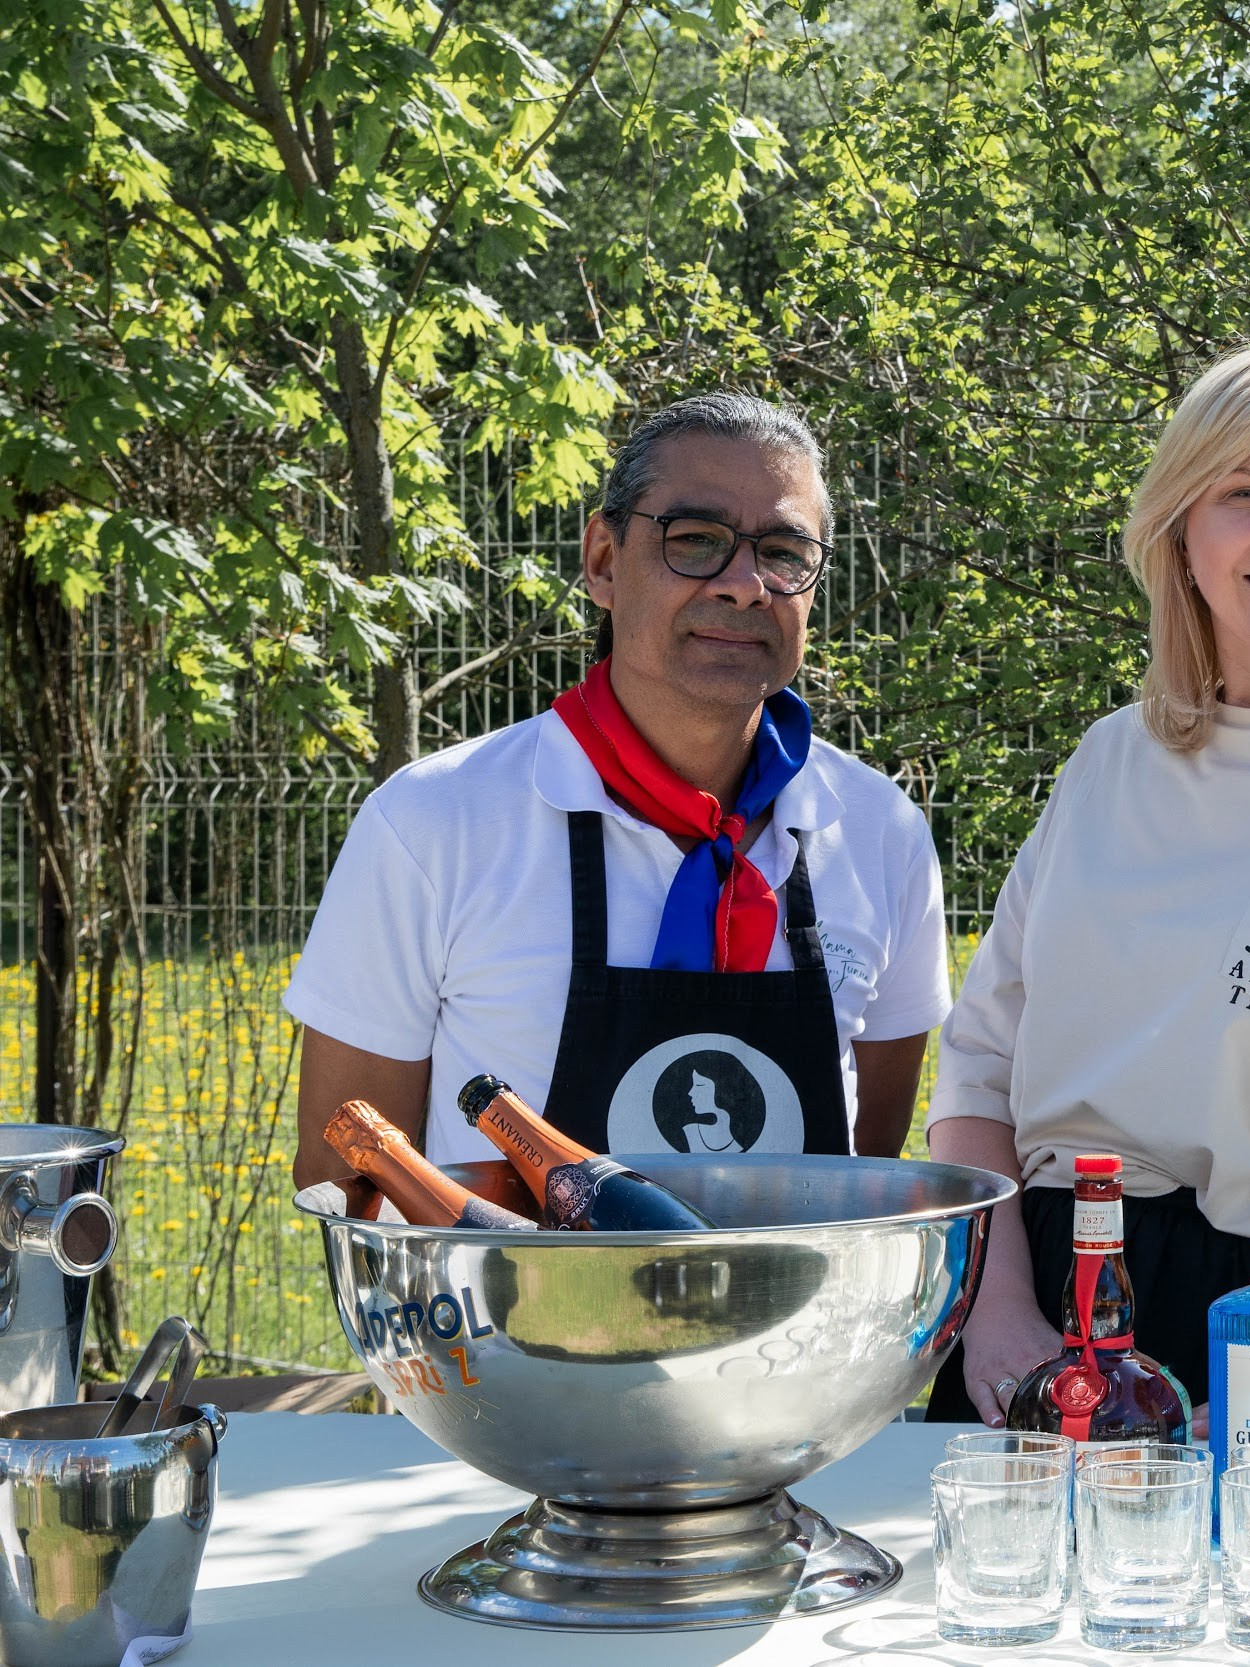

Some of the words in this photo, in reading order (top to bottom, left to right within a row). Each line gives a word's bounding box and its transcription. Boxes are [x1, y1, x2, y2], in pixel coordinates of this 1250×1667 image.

[488, 1112, 544, 1168] CRÉMANT
[570, 1196, 589, 1219] BRUT
[1081, 1216, 1105, 1224] 1827
